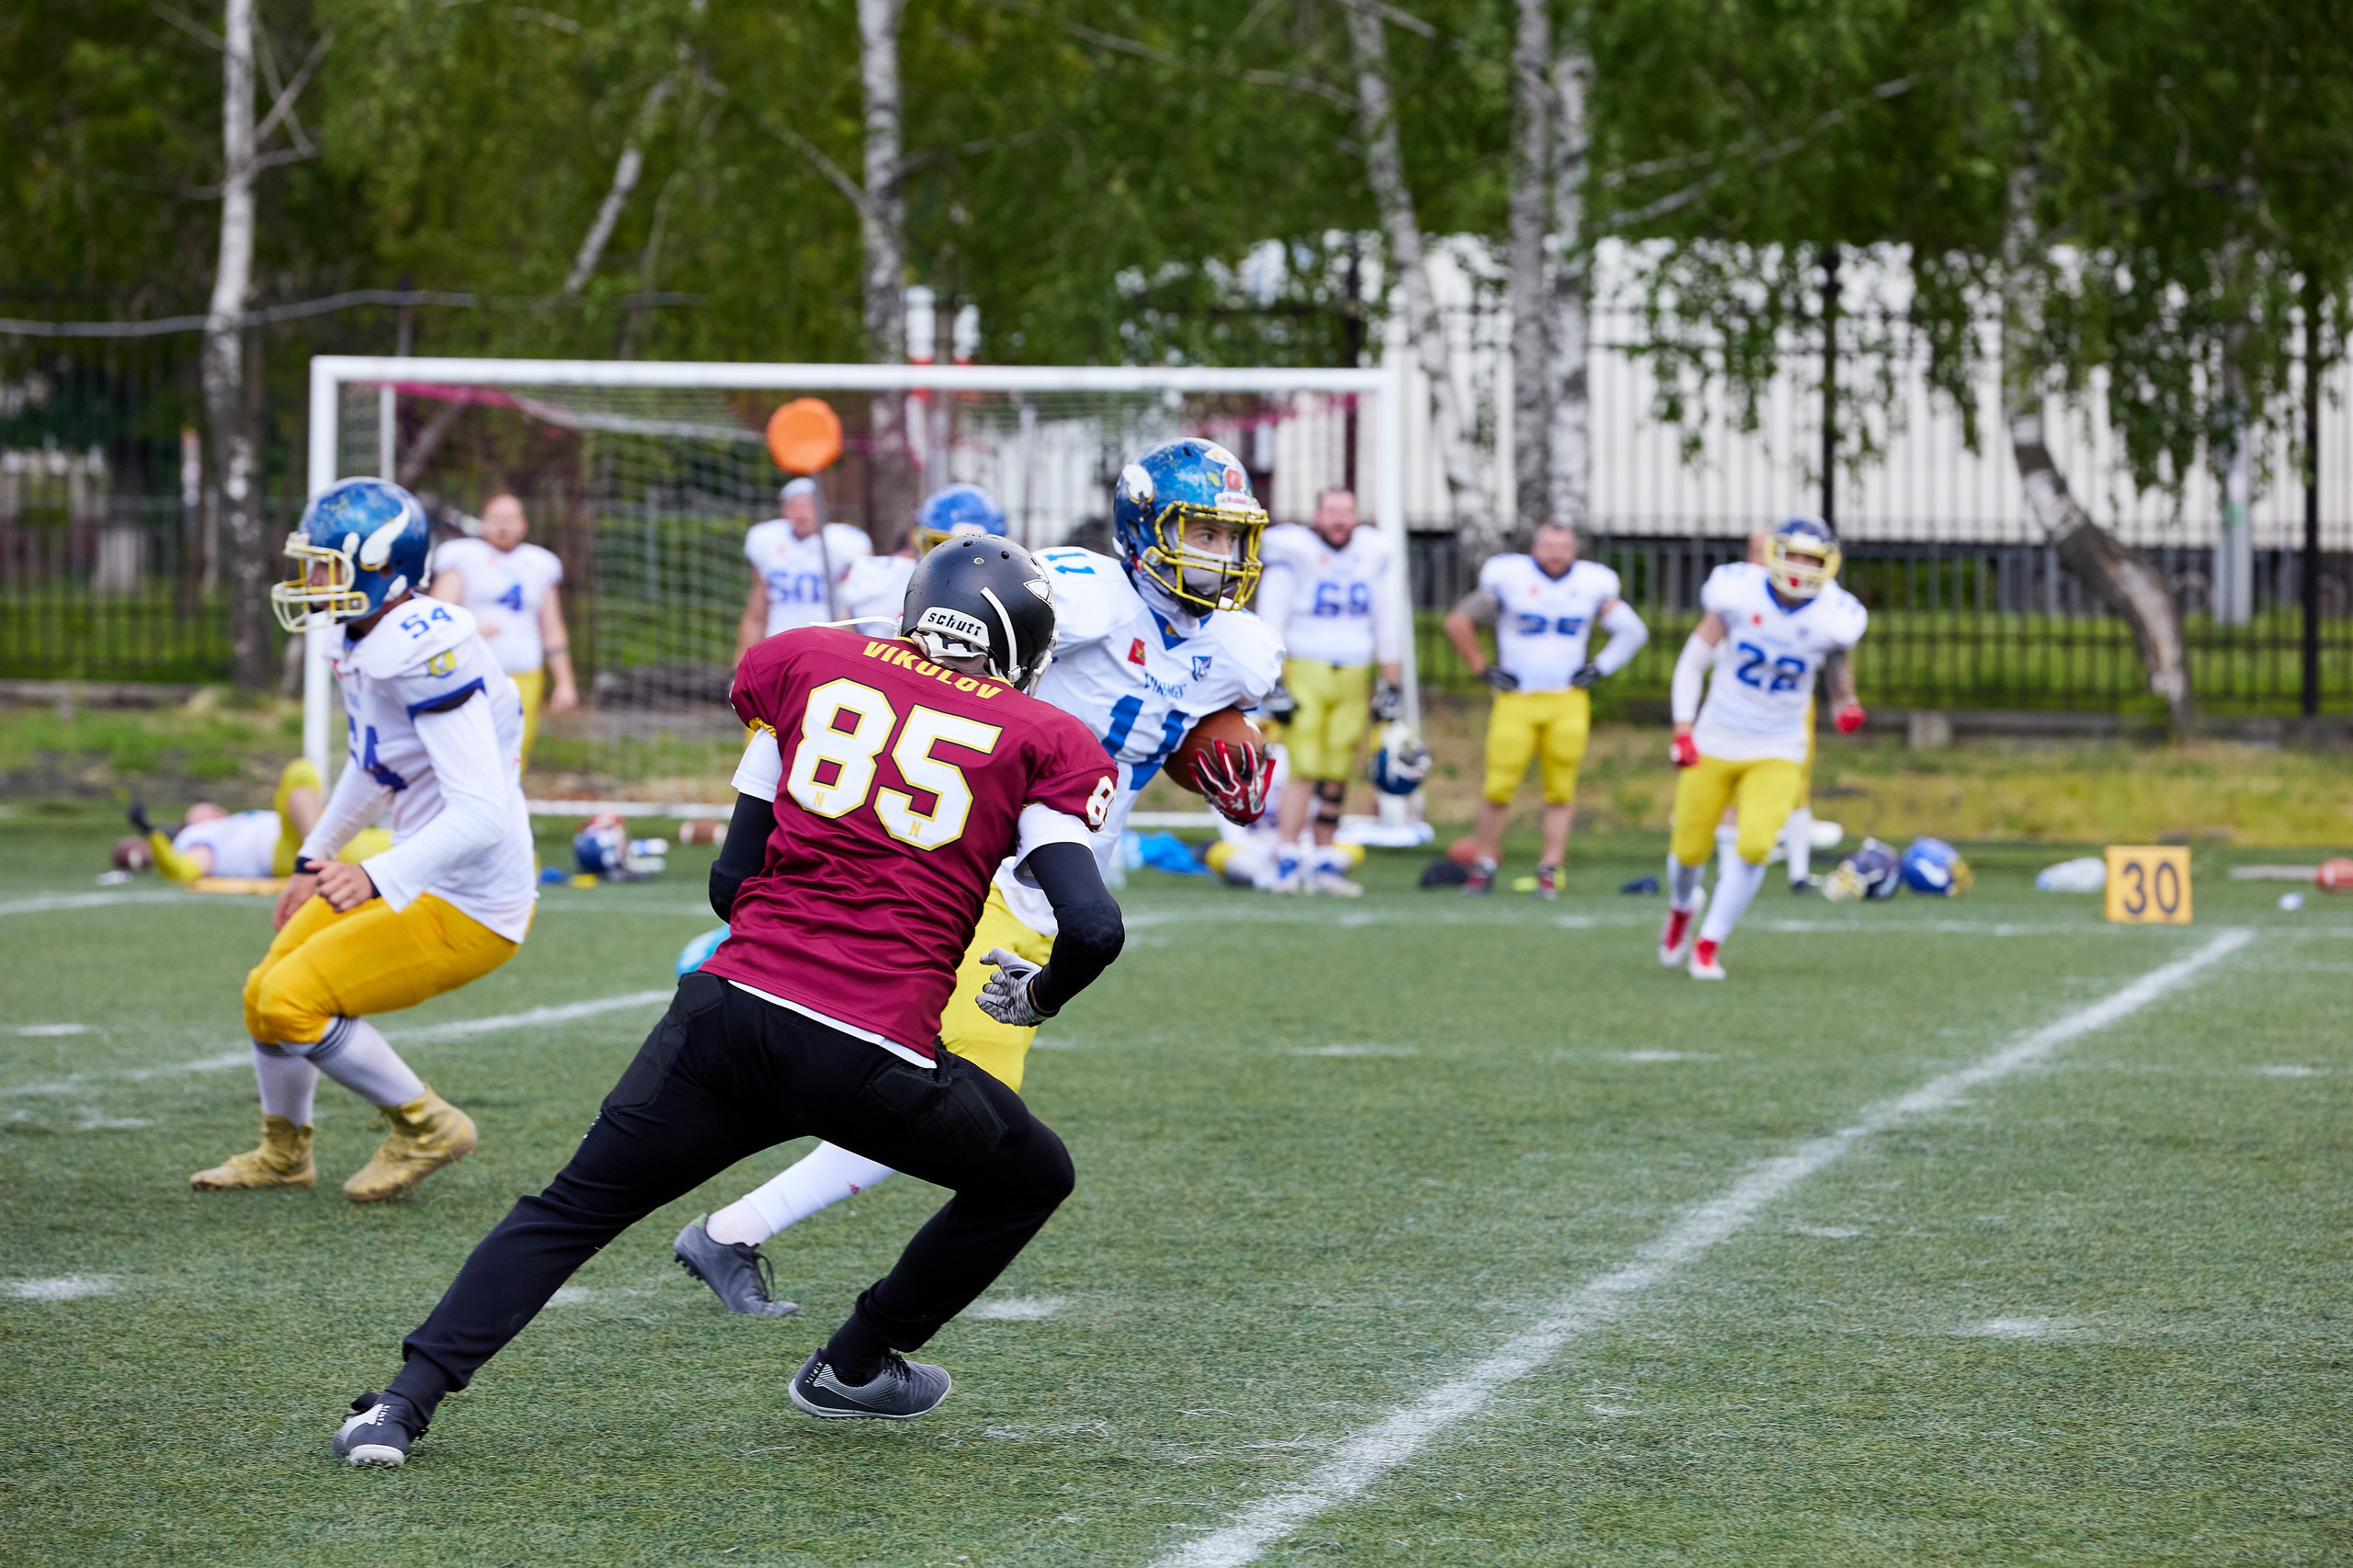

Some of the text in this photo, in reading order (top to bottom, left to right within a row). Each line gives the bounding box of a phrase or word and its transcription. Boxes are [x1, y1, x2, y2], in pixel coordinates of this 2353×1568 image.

[497, 583, 524, 612] 4
[399, 607, 455, 639] 54
[927, 611, 983, 636] schutt
[787, 676, 1005, 852] 85
[2122, 861, 2180, 915] 30
